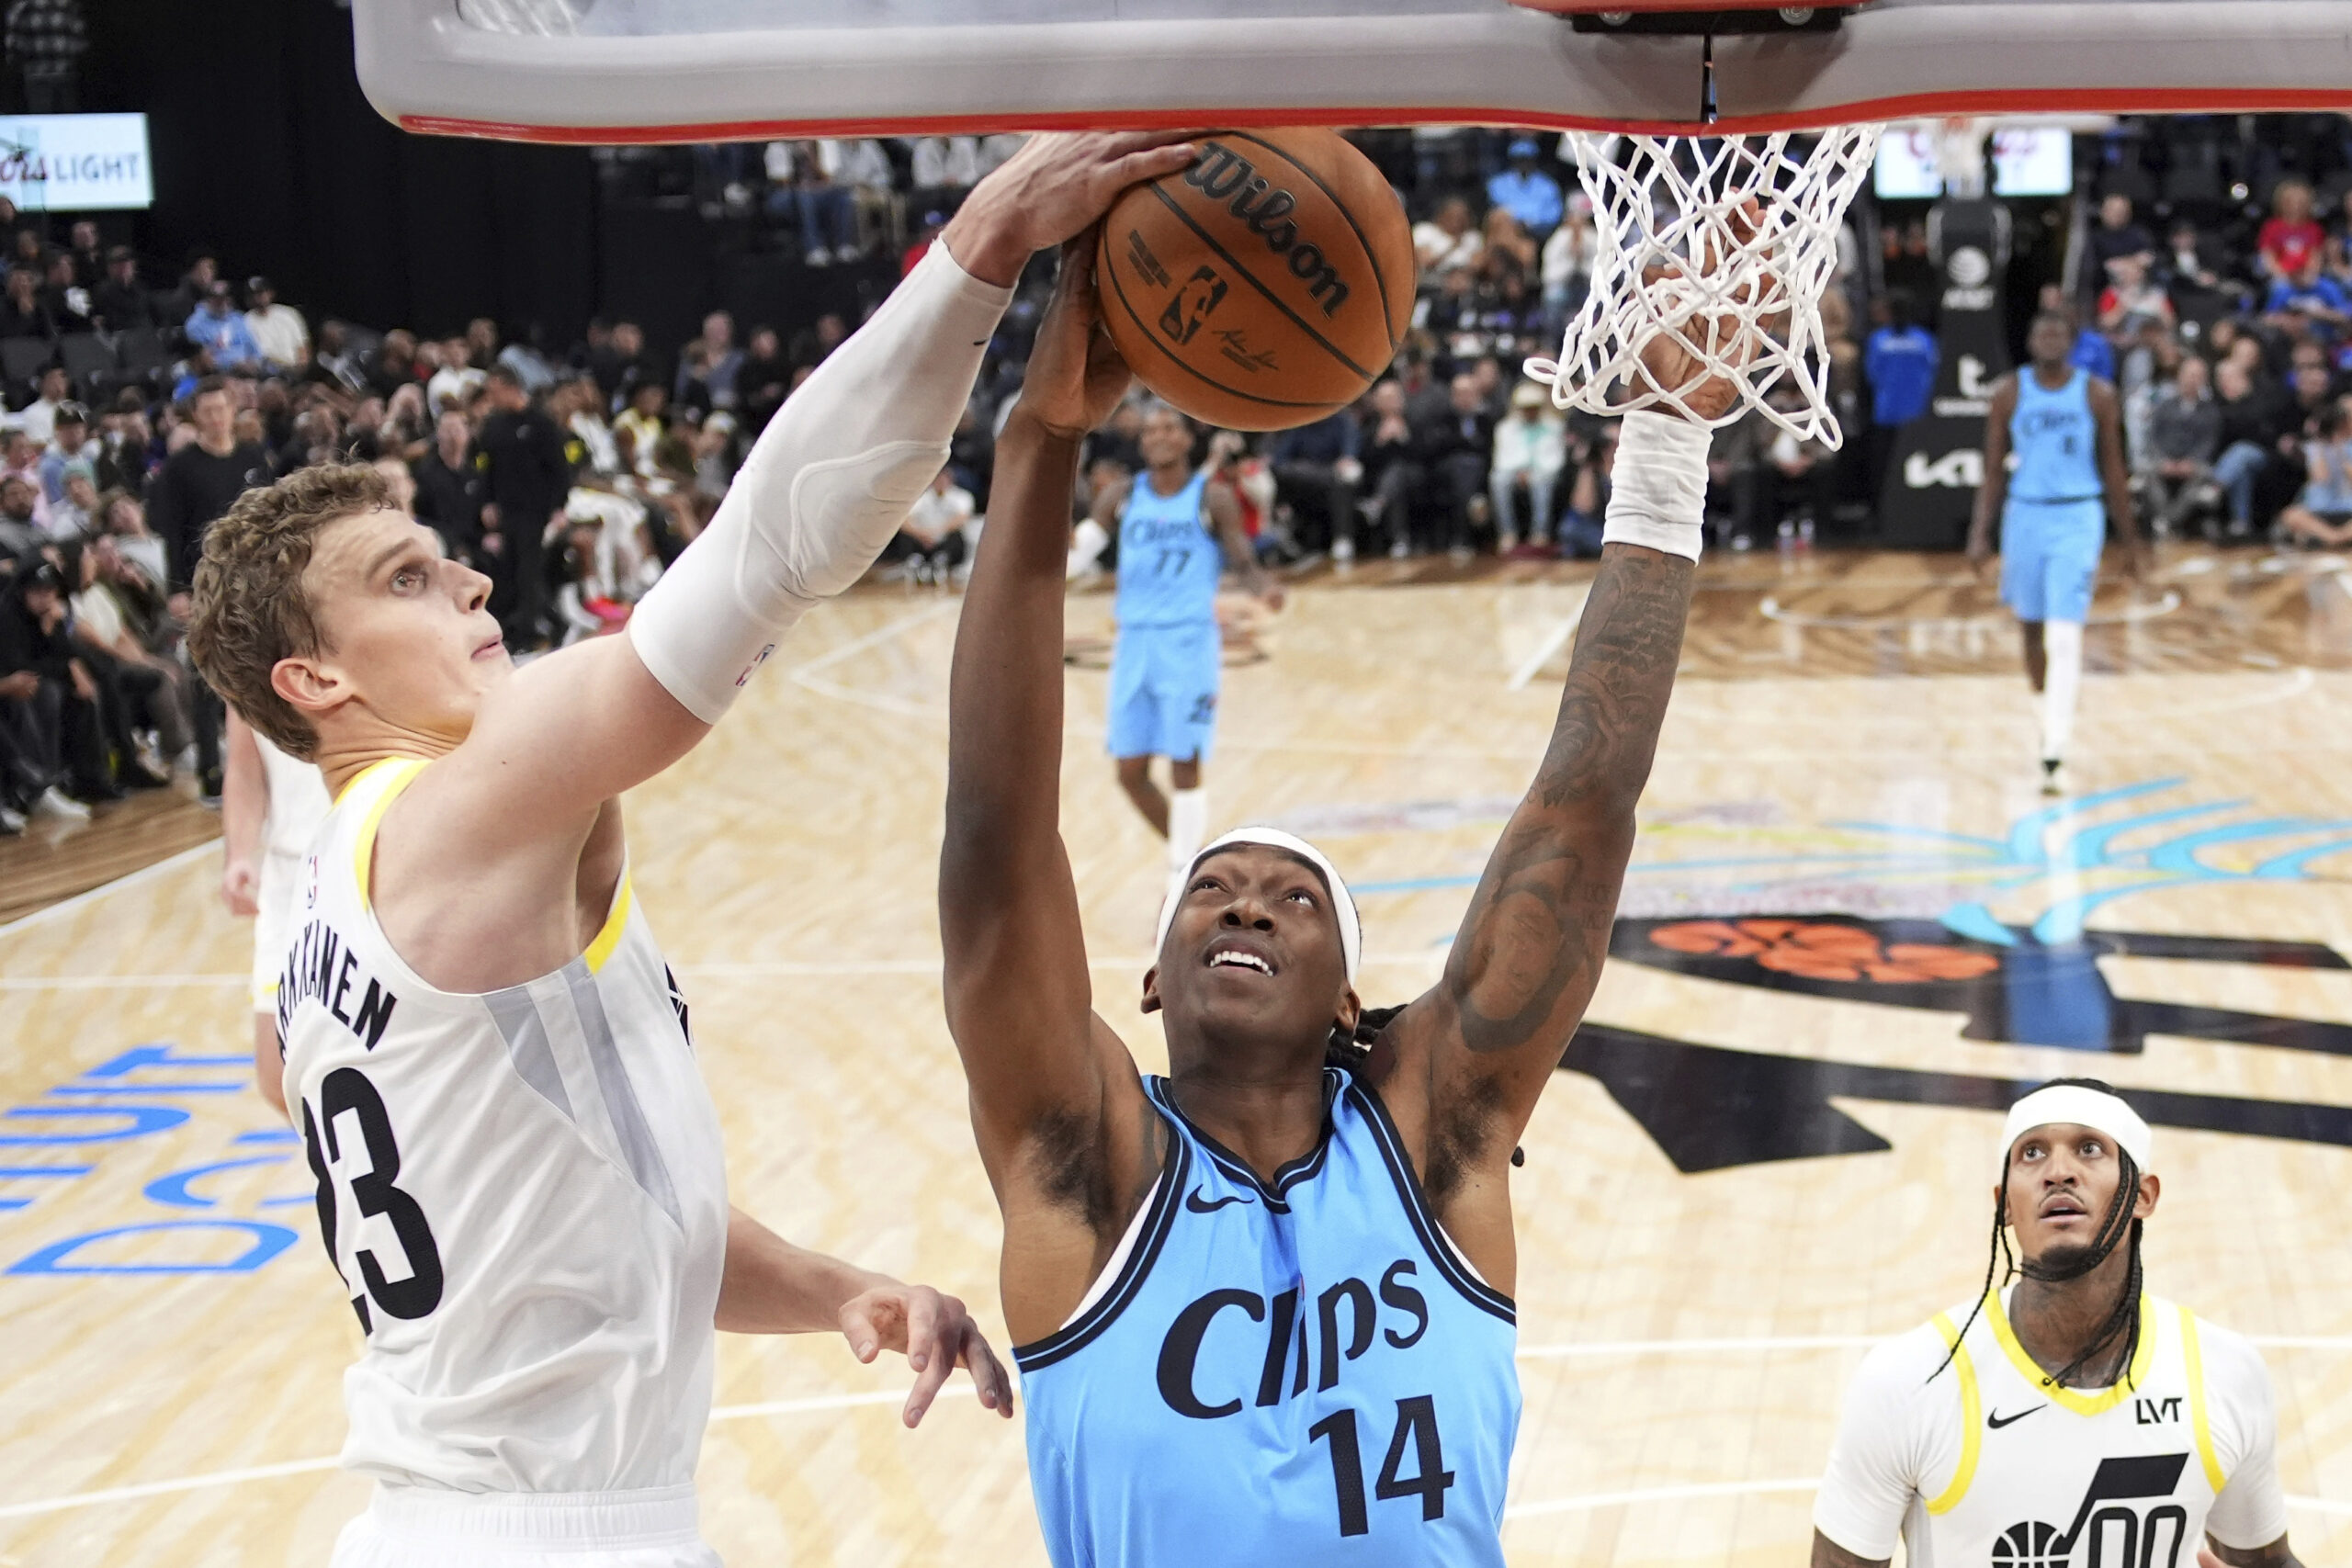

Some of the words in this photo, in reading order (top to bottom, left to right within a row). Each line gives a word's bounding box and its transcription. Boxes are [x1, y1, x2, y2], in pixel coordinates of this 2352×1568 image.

[53, 152, 141, 183] LIGHT
[1183, 141, 1351, 320] Wilson
[1155, 548, 1192, 577] 77
[276, 919, 398, 1066] ARKKANEN
[1156, 1258, 1429, 1419] Clips
[2135, 1397, 2183, 1425] LVT
[1308, 1394, 1455, 1538] 14
[2086, 1505, 2187, 1568] 00
